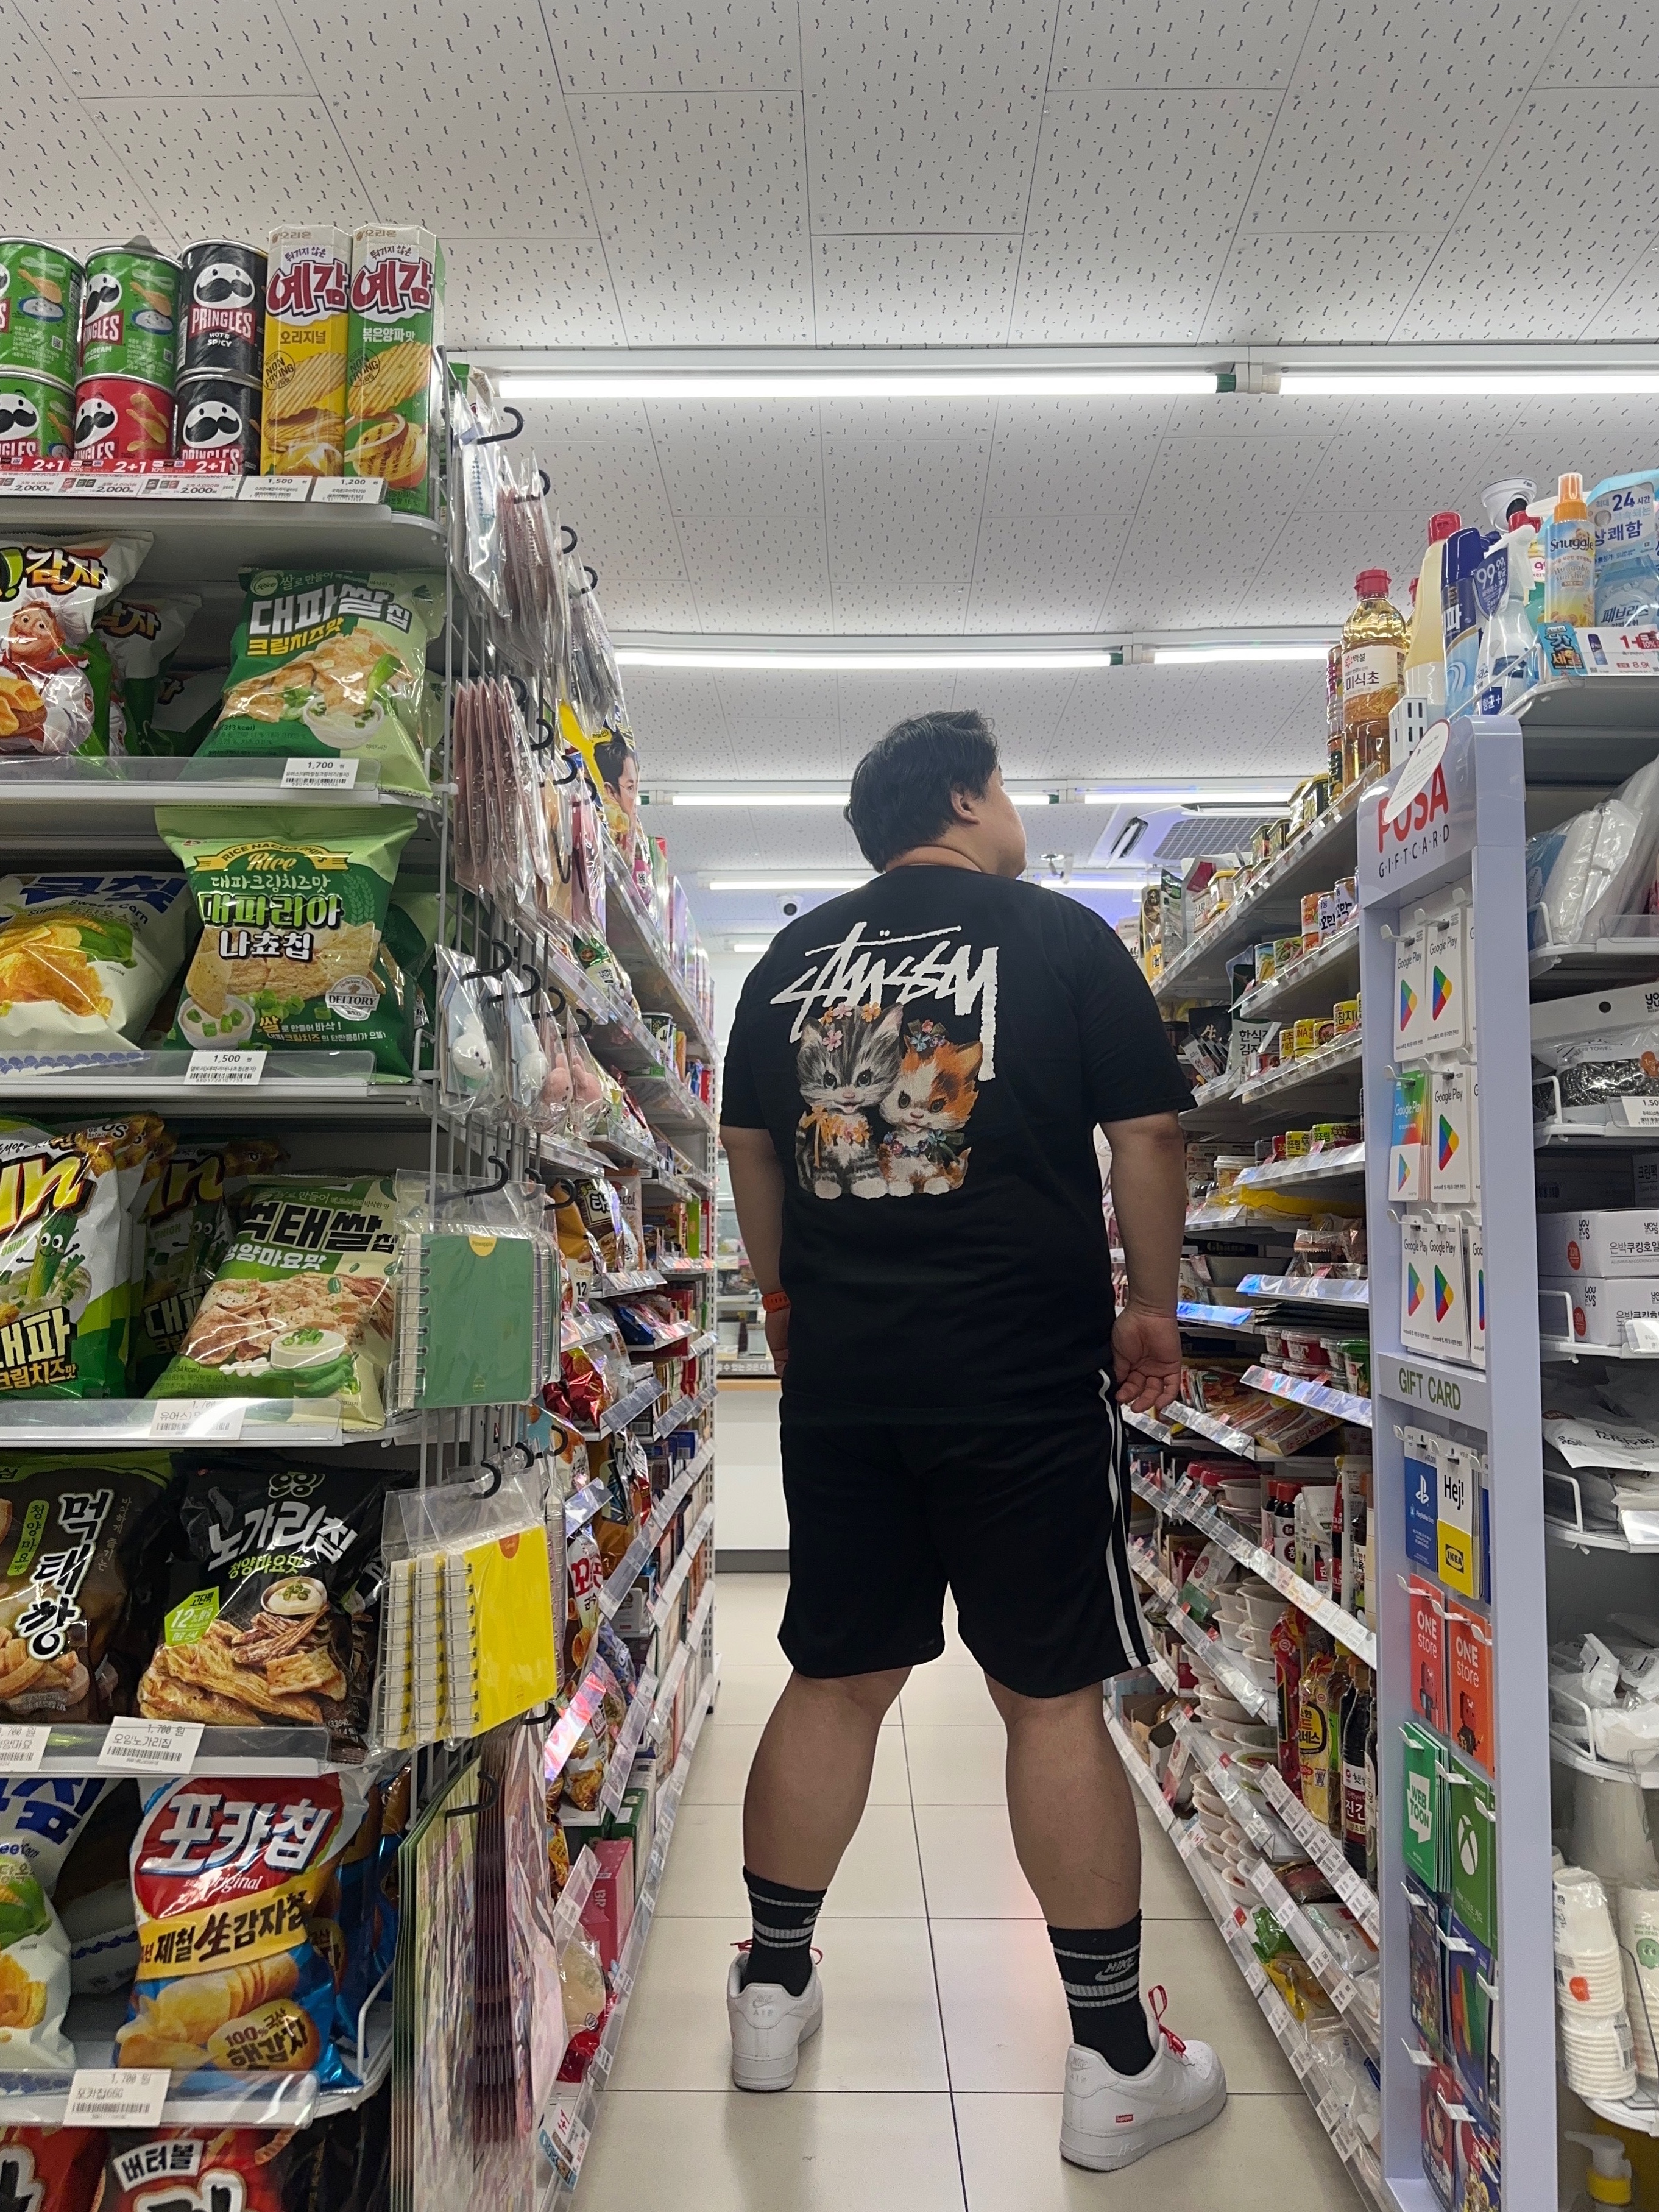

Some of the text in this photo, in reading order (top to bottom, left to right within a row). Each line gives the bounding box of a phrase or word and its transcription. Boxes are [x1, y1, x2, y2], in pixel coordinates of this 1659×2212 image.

[285, 246, 326, 262] 튀기지 않은
[370, 245, 412, 260] 튀기지 않은
[266, 260, 349, 313] 예감
[352, 258, 433, 311] 예감
[191, 307, 252, 339] PRINGLES
[207, 339, 232, 347] SPICY
[280, 330, 326, 344] 오리지널
[363, 327, 416, 342] 볶은양파맛
[90, 346, 112, 355] CREAM
[266, 354, 285, 377] NON
[265, 364, 294, 388] FRYING
[31, 459, 64, 472] 2+1
[113, 461, 147, 473] 2+1
[194, 460, 227, 473] 2+1
[1612, 492, 1635, 511] 24
[1636, 495, 1651, 504] 시간
[1550, 536, 1594, 553] Snuggle
[249, 583, 412, 634] 대파쌀칩
[247, 617, 345, 655] 크림치즈맛
[1353, 653, 1365, 663] 백설
[1346, 671, 1380, 690] 미식초
[221, 846, 249, 862] RICE
[252, 843, 298, 851] NACHO
[247, 852, 297, 871] Rice
[211, 874, 331, 894] 대파크림치즈맛
[29, 899, 149, 925] Super Sweet Corn
[198, 893, 342, 927] 대파리아
[220, 930, 312, 961] 나쵸칩
[1430, 936, 1458, 956] Google Play
[1397, 952, 1423, 970] Google Play
[328, 994, 377, 1006] DELTORY
[213, 1055, 240, 1064] 1,500
[1435, 1088, 1462, 1104] Google Play
[1395, 1104, 1412, 1118] Google
[1404, 1239, 1418, 1256] Google
[1429, 1239, 1456, 1257] Google Play
[1609, 1241, 1659, 1254] 은박쿠킹호일
[576, 1281, 587, 1296] 12
[1399, 1368, 1462, 1411] GIFT CARD
[1445, 1475, 1465, 1510] Hej!
[208, 1501, 358, 1571] 노가리칩
[228, 1554, 306, 1580] 청양마요맛
[1446, 1550, 1463, 1566] IKEA
[17, 1490, 115, 1659] 먹태깡
[1417, 1610, 1437, 1641] ONE
[1418, 1633, 1437, 1659] store
[1456, 1636, 1479, 1669] ONE
[1457, 1661, 1479, 1688] store
[148, 1724, 185, 1736] 1,700 원
[112, 1734, 172, 1749] 오잉노가리칩
[1411, 1784, 1427, 1811] WEB
[1409, 1798, 1429, 1829] TOON
[140, 1794, 333, 1873] 포카칩
[154, 1925, 194, 1963] 제철
[1105, 1955, 1135, 1973] NIKE
[111, 2073, 136, 2084] 1,700
